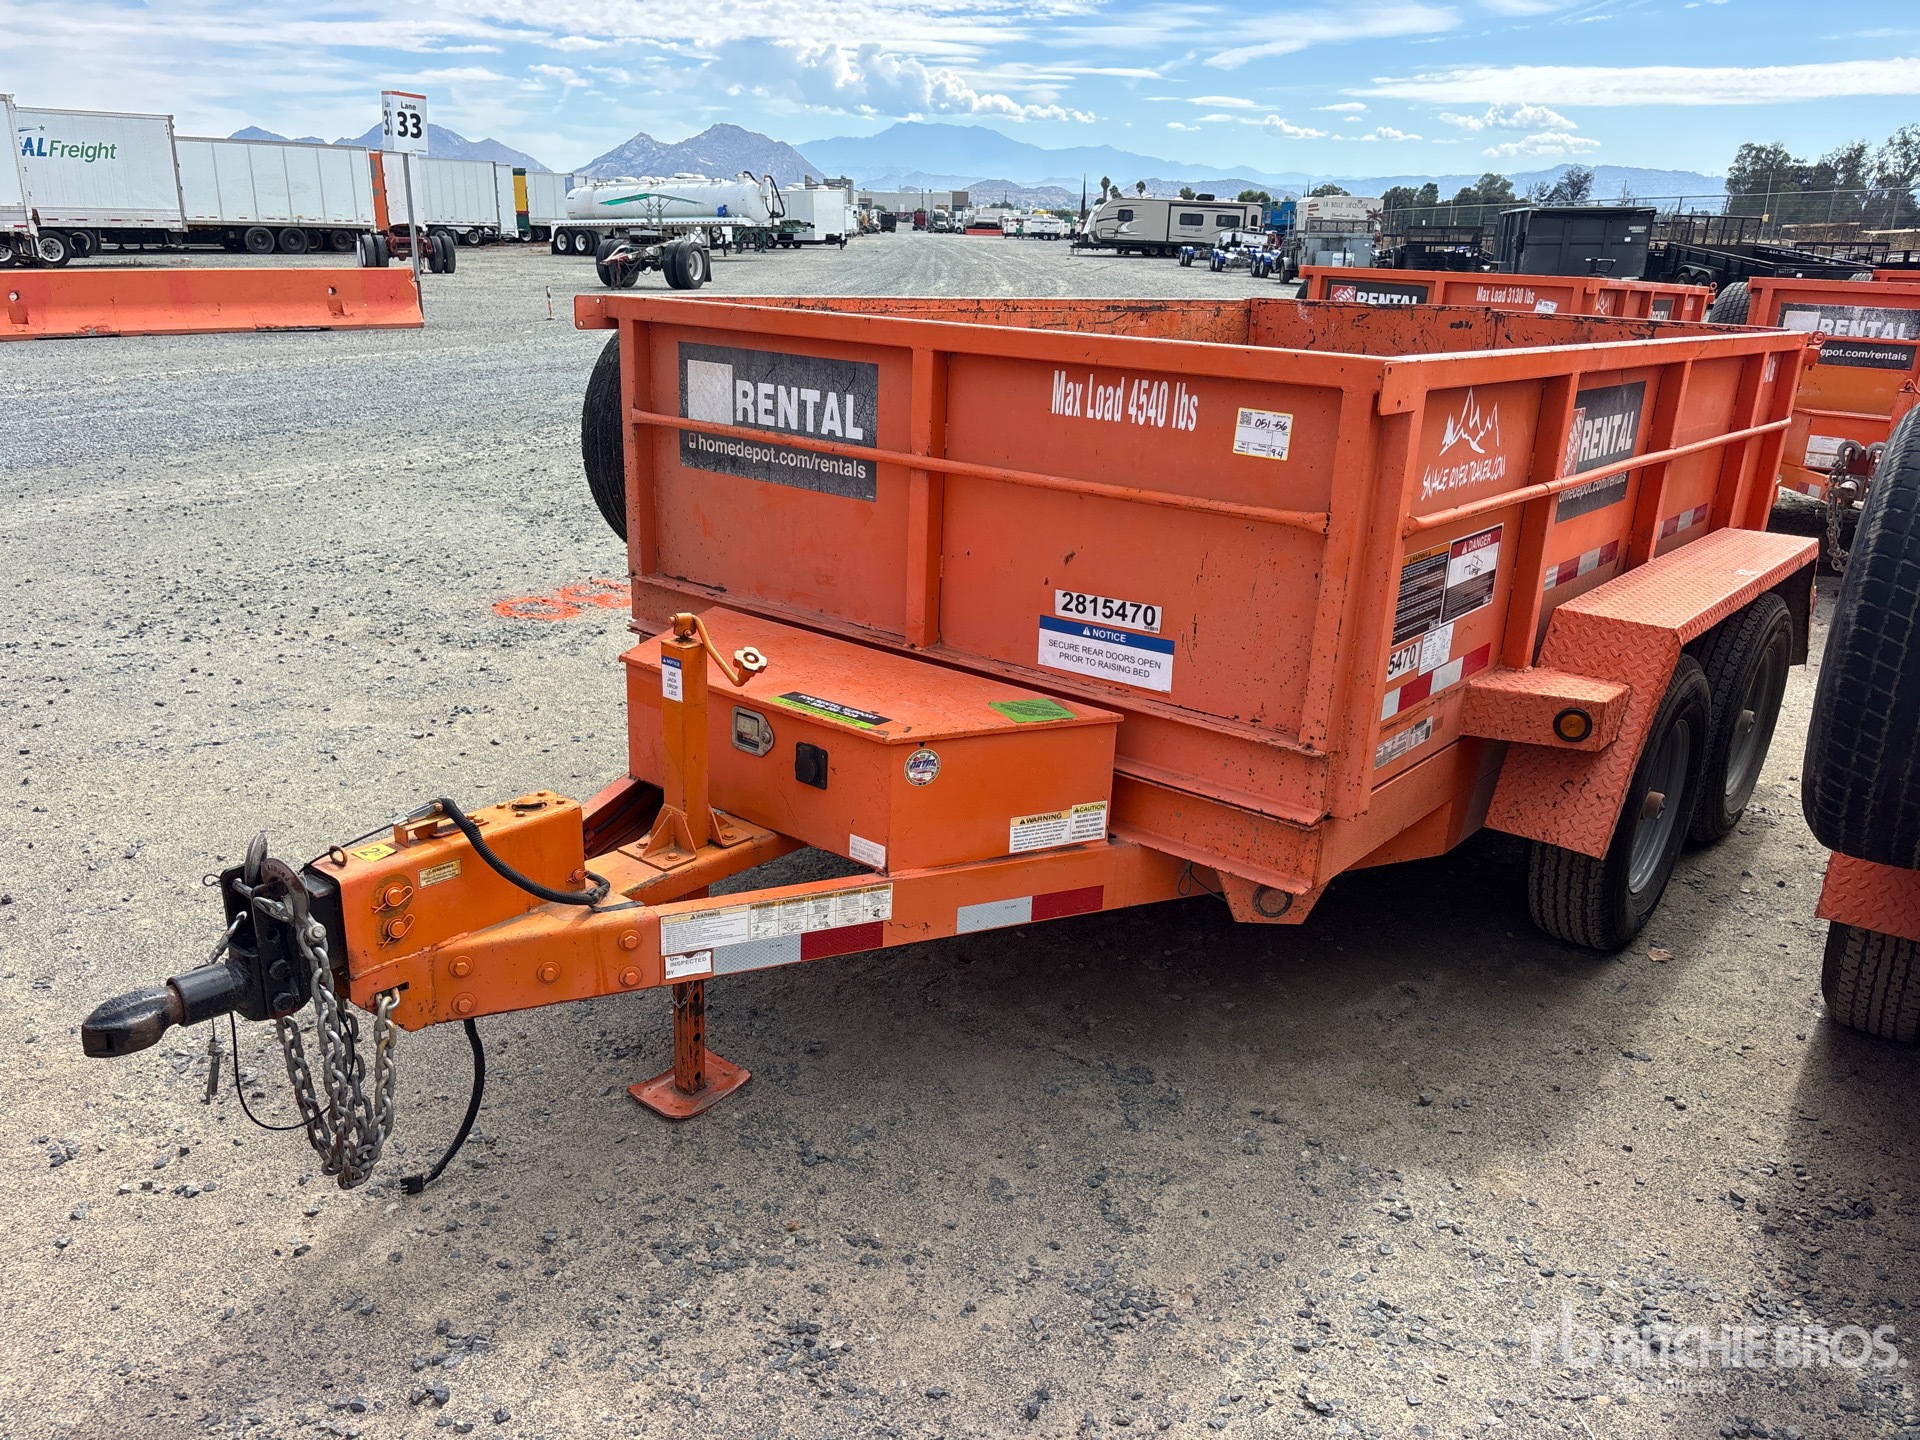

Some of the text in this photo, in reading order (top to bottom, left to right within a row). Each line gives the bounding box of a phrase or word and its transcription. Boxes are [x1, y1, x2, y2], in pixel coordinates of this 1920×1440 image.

[401, 101, 417, 111] Lane
[397, 111, 422, 139] 33
[1356, 292, 1418, 305] RENTAL
[1476, 286, 1535, 304] Max Load 3130 lbs
[1819, 319, 1910, 340] RENTAL
[736, 379, 863, 440] RENTAL
[1052, 370, 1199, 431] Max Load 4540 lbs
[1579, 411, 1634, 462] RENTAL
[698, 434, 867, 479] homedepot.com/rentals
[1448, 461, 1469, 490] RIVER
[1468, 533, 1491, 551] DANGER
[1061, 591, 1156, 627] 2815470
[1092, 628, 1127, 643] NOTICE
[1048, 638, 1161, 670] SECURE REAR DOORS OPEN
[1059, 651, 1150, 678] PRIOR TO RAISING BED
[1388, 644, 1417, 675] 5470
[1026, 813, 1062, 823] WARNING
[1080, 804, 1105, 813] CAUTION
[697, 910, 721, 919] WARNING
[670, 956, 707, 968] INSPECTED
